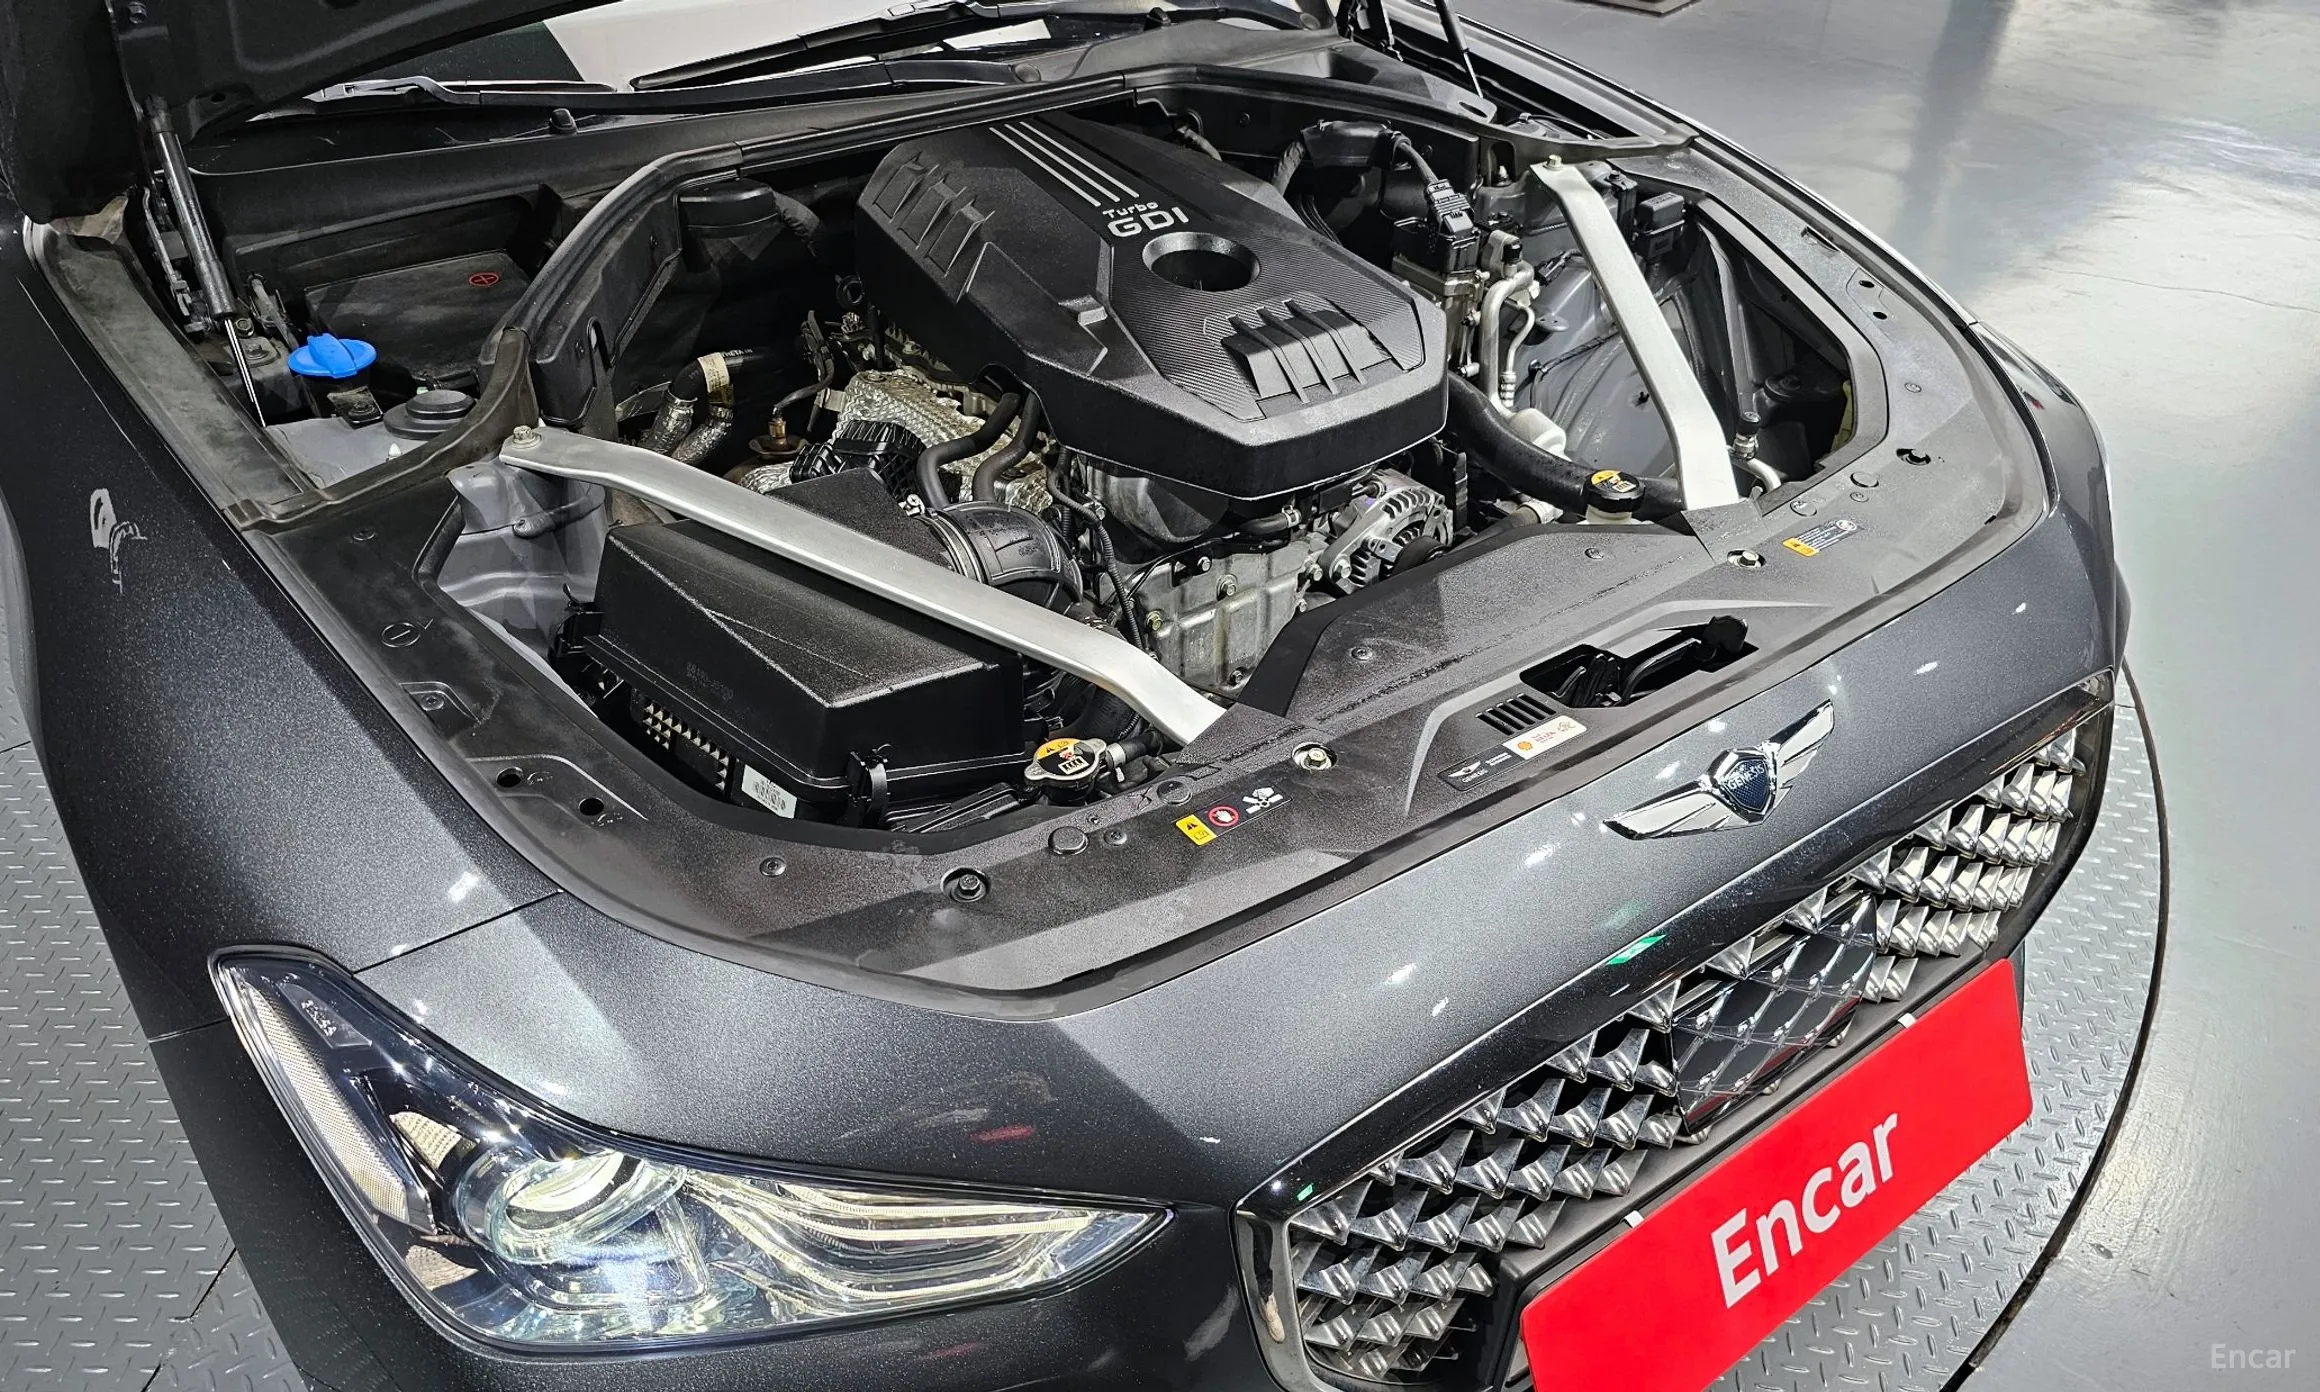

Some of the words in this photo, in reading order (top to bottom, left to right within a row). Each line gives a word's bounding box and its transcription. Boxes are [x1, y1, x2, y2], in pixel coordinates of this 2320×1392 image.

[1101, 202, 1159, 219] Turbo
[1107, 206, 1189, 238] GDI
[1727, 764, 1765, 790] GENESIS
[1711, 1112, 1898, 1309] Encar
